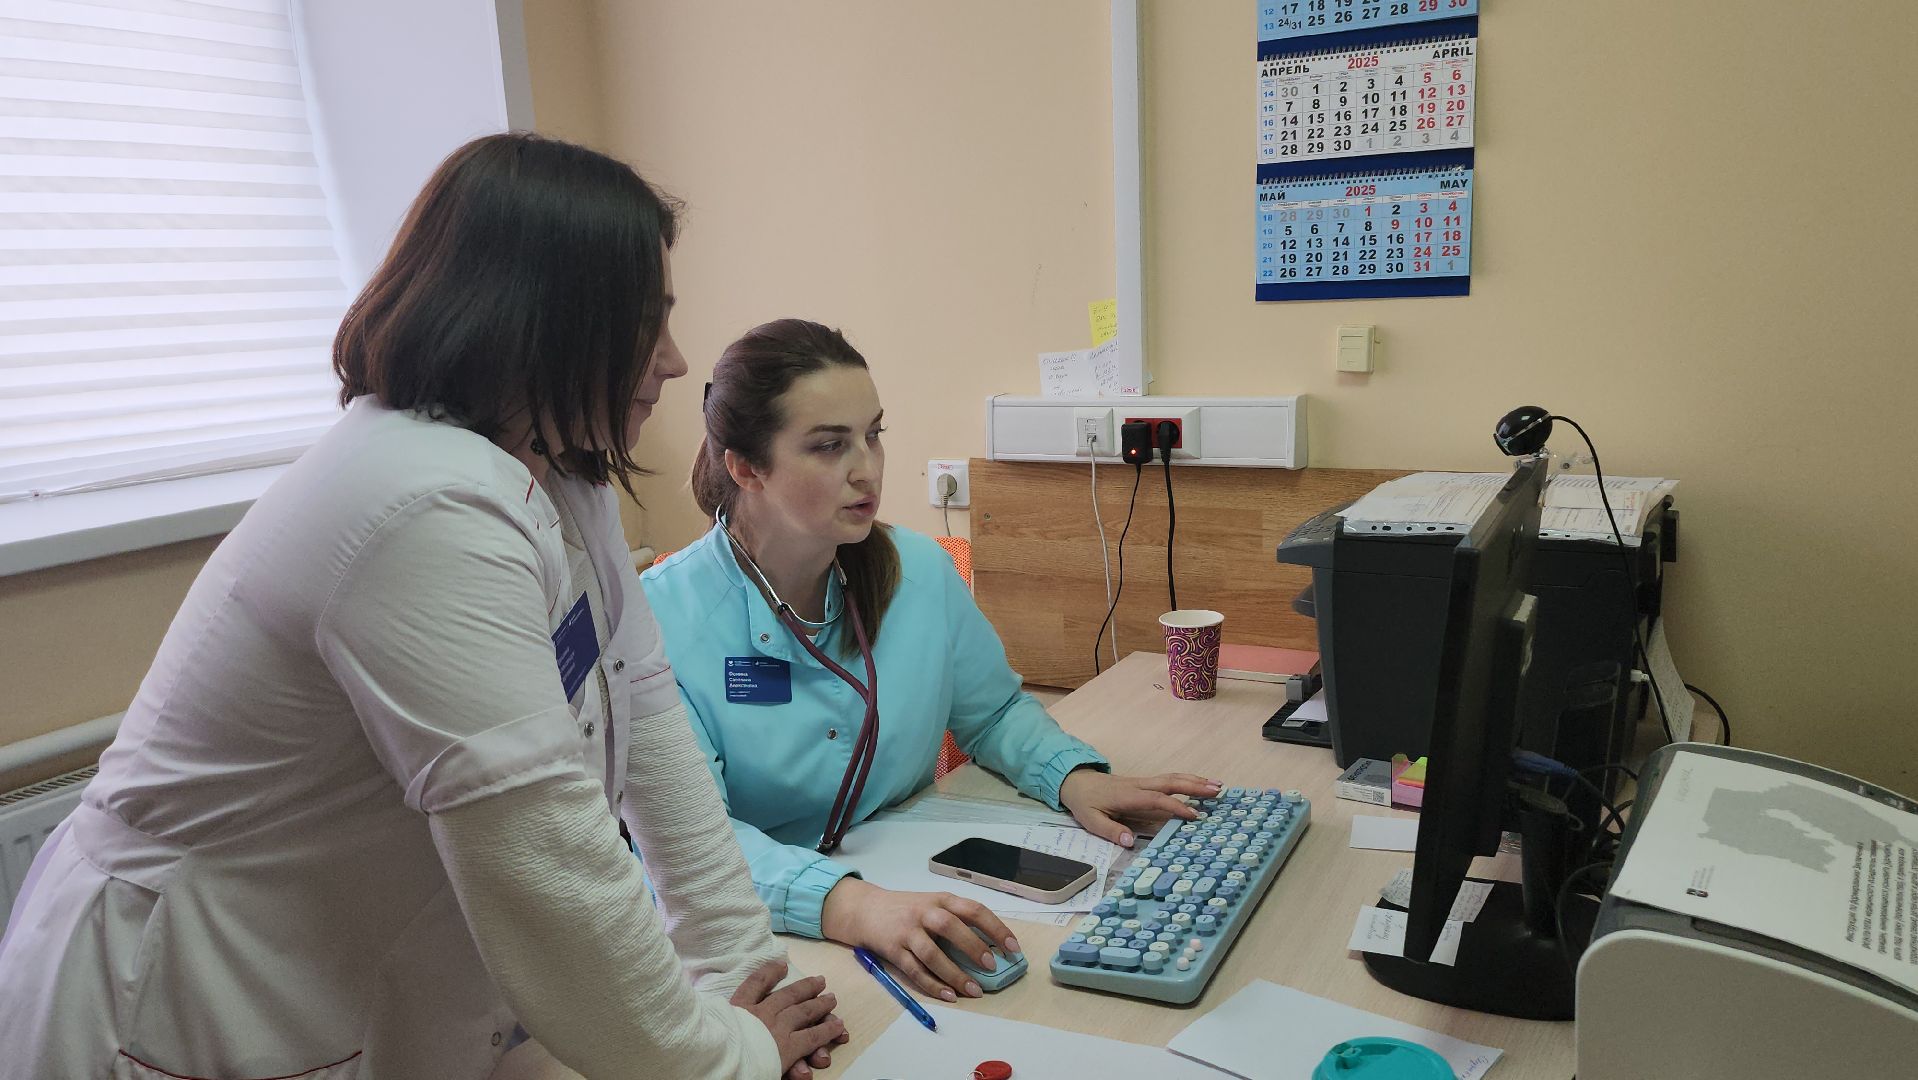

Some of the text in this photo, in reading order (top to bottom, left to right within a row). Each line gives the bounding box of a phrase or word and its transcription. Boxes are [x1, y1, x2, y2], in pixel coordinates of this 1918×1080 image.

[1282, 3, 1298, 15] 17
[1309, 0, 1325, 11] 18
[1308, 14, 1325, 26] 25
[1335, 11, 1352, 23] 26
[1362, 7, 1380, 19] 27
[1391, 3, 1408, 15] 28
[1419, 0, 1438, 11] 29
[1432, 46, 1473, 59] APRIL
[1262, 65, 1309, 77] АПРЕЛЬ
[1348, 56, 1378, 69] 2025
[1282, 86, 1298, 97] 30
[1313, 84, 1318, 94] 1
[1340, 82, 1347, 92] 2
[1368, 79, 1374, 89] 3
[1395, 75, 1403, 86] 4
[1424, 72, 1431, 83] 5
[1453, 70, 1461, 80] 6
[1286, 101, 1293, 112] 7
[1313, 99, 1320, 109] 8
[1340, 96, 1347, 106] 9
[1362, 93, 1379, 104] 10
[1391, 90, 1406, 101] 11
[1419, 87, 1436, 99] 12
[1448, 84, 1465, 96] 13
[1282, 115, 1298, 126] 14
[1308, 113, 1324, 124] 15
[1335, 110, 1351, 121] 16
[1362, 107, 1379, 119] 17
[1390, 105, 1407, 116] 18
[1418, 103, 1435, 114] 19
[1446, 100, 1465, 111] 20
[1281, 130, 1296, 141] 21
[1307, 128, 1324, 139] 22
[1334, 125, 1351, 136] 23
[1361, 122, 1379, 134] 24
[1389, 120, 1406, 131] 25
[1417, 117, 1435, 129] 26
[1446, 115, 1464, 127] 27
[1281, 144, 1297, 155] 28
[1308, 142, 1324, 153] 29
[1334, 140, 1351, 151] 30
[1367, 138, 1372, 148] 1
[1393, 135, 1402, 146] 2
[1422, 133, 1430, 143] 3
[1450, 130, 1459, 140] 4
[1346, 185, 1375, 196] 2025
[1441, 179, 1468, 189] MAY
[1260, 190, 1285, 201] МАЙ
[1280, 211, 1296, 222] 28
[1307, 210, 1323, 220] 29
[1334, 208, 1349, 218] 30
[1365, 206, 1370, 216] 1
[1392, 205, 1400, 215] 2
[1420, 203, 1427, 213] 3
[1449, 200, 1457, 211] 4
[1285, 226, 1292, 235] 5
[1311, 224, 1318, 234] 6
[1338, 223, 1344, 232] 7
[1365, 221, 1372, 231] 8
[1391, 219, 1399, 229] 9
[1415, 217, 1432, 228] 10
[1444, 216, 1460, 226] 11
[1281, 239, 1296, 250] 12
[1307, 238, 1322, 248] 13
[1333, 236, 1350, 247] 14
[1360, 235, 1377, 246] 15
[1387, 234, 1404, 244] 16
[1415, 232, 1432, 242] 17
[1443, 231, 1461, 241] 18
[1280, 254, 1296, 264] 19
[1306, 252, 1322, 262] 20
[1333, 251, 1347, 261] 21
[1359, 249, 1376, 260] 22
[1386, 248, 1403, 258] 23
[1414, 246, 1432, 257] 24
[1442, 245, 1460, 256] 25
[1280, 268, 1296, 278] 26
[1306, 267, 1322, 276] 27
[1332, 265, 1348, 275] 28
[1359, 264, 1376, 274] 29
[1386, 263, 1403, 273] 30
[1414, 261, 1430, 272] 31
[1448, 260, 1453, 270] 1
